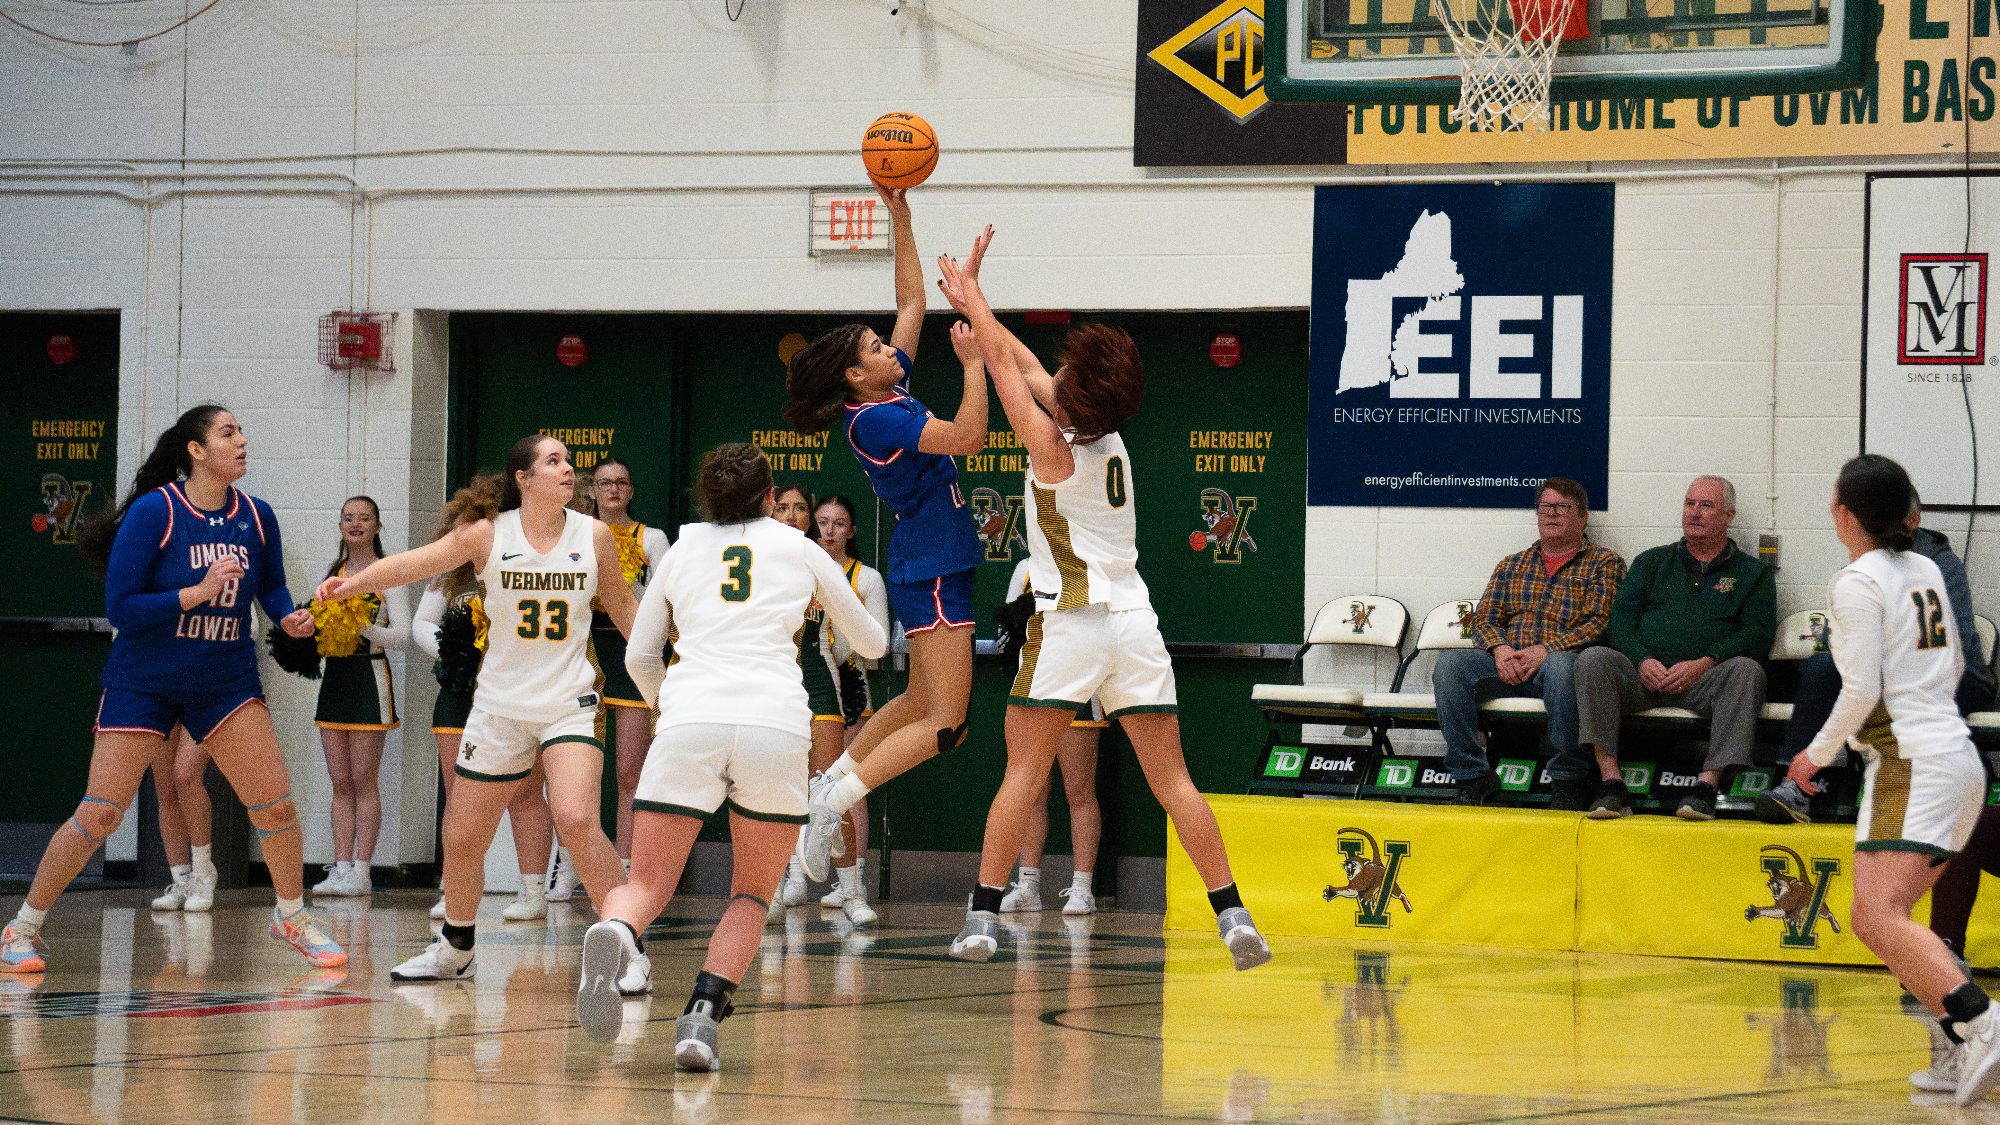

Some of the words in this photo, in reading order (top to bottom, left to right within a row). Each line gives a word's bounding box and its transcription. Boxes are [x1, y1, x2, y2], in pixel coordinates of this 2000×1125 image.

[1354, 104, 1524, 135] FUU
[867, 128, 914, 144] Wilson
[830, 200, 877, 241] EXIT
[1389, 294, 1584, 399] EEI
[1907, 372, 1941, 383] SINCE
[1334, 408, 1394, 423] ENERGY
[1398, 408, 1470, 423] EFFICIENT
[1474, 408, 1582, 424] INVESTMENTS
[32, 420, 105, 437] EMERGENCY
[752, 430, 830, 448] EMERGENCY
[1189, 431, 1273, 449] EMERGENCY
[37, 443, 63, 459] EXIT
[68, 443, 99, 459] ONLY
[765, 453, 786, 471] XIT
[790, 453, 823, 471] ONLY
[966, 455, 996, 472] EXIT
[1195, 455, 1226, 473] EXIT
[1230, 455, 1266, 473] ONLY
[1106, 455, 1127, 509] 0
[1364, 472, 1548, 489] energyefficientinvestments.com
[500, 570, 587, 591] VERMONT
[720, 545, 753, 603] 3
[516, 598, 570, 642] 33
[1910, 588, 1948, 650] 12
[1274, 751, 1301, 771] TD
[1309, 755, 1356, 772] Bank
[1384, 765, 1412, 785] TD
[1421, 768, 1456, 784] Ban
[1501, 764, 1530, 784] TD
[1659, 771, 1697, 787] Ban
